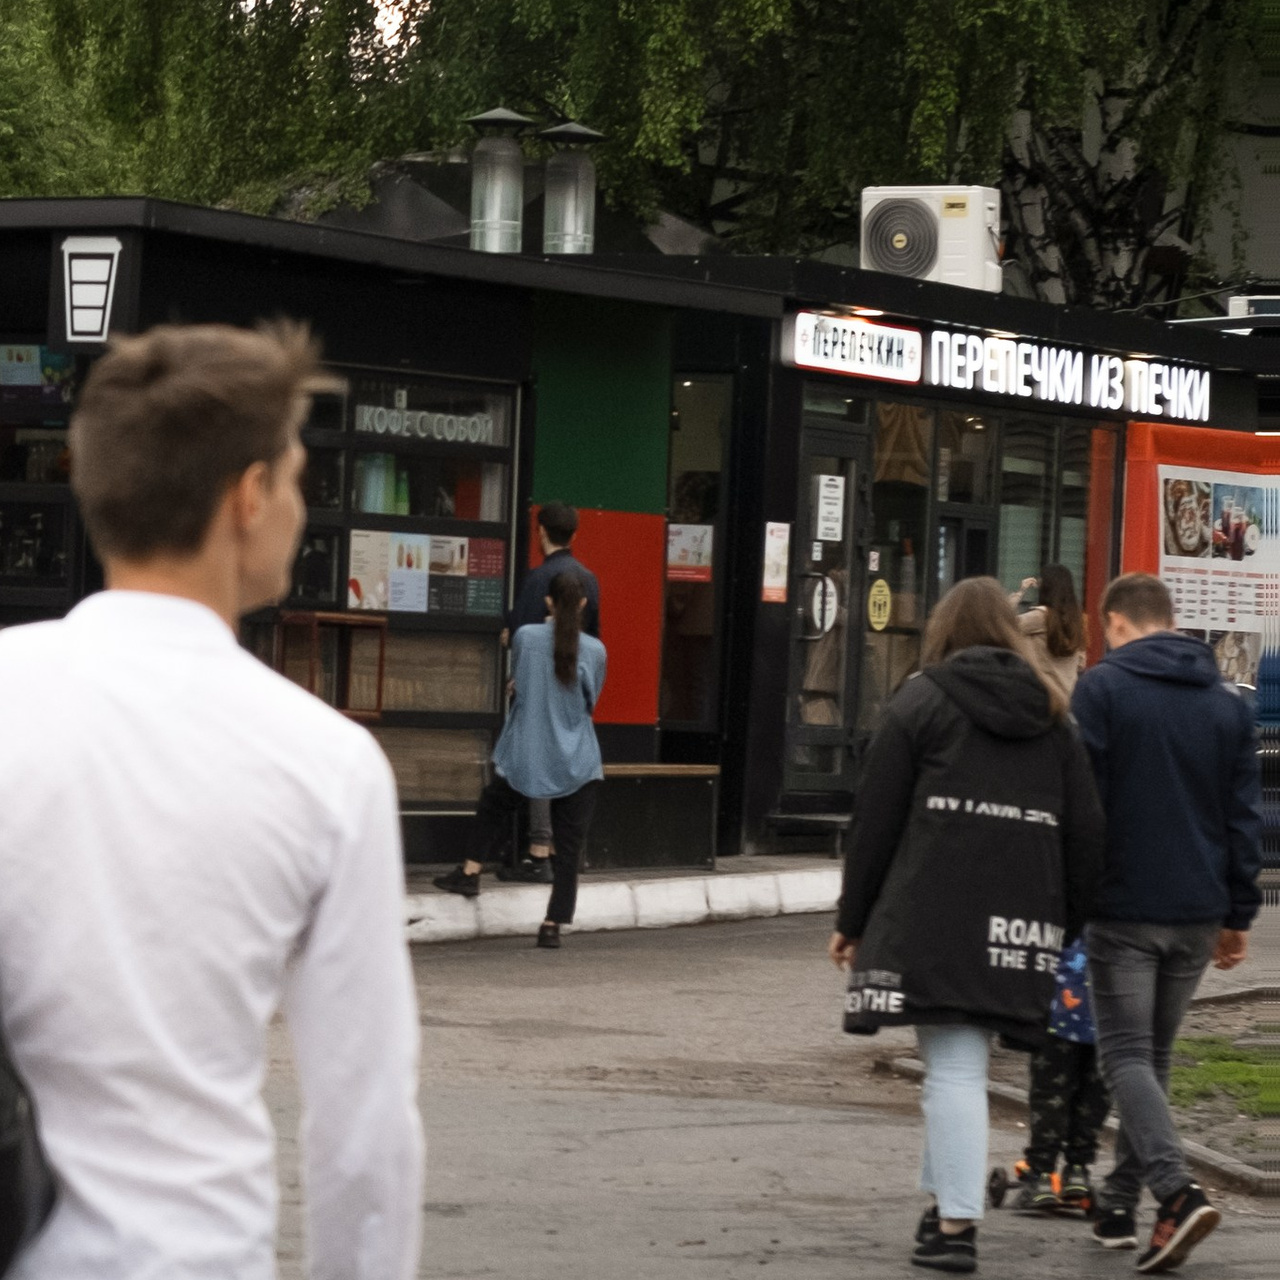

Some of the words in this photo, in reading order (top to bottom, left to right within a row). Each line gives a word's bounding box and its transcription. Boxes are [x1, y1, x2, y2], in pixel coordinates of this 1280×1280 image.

[931, 330, 1084, 405] ПЕРЕПЕЧКИ
[1090, 353, 1124, 410] ИЗ
[1130, 359, 1210, 422] ПЕЧКИ
[362, 406, 411, 437] КОФЕ
[433, 412, 493, 445] СОБОЙ
[987, 946, 1028, 970] THE
